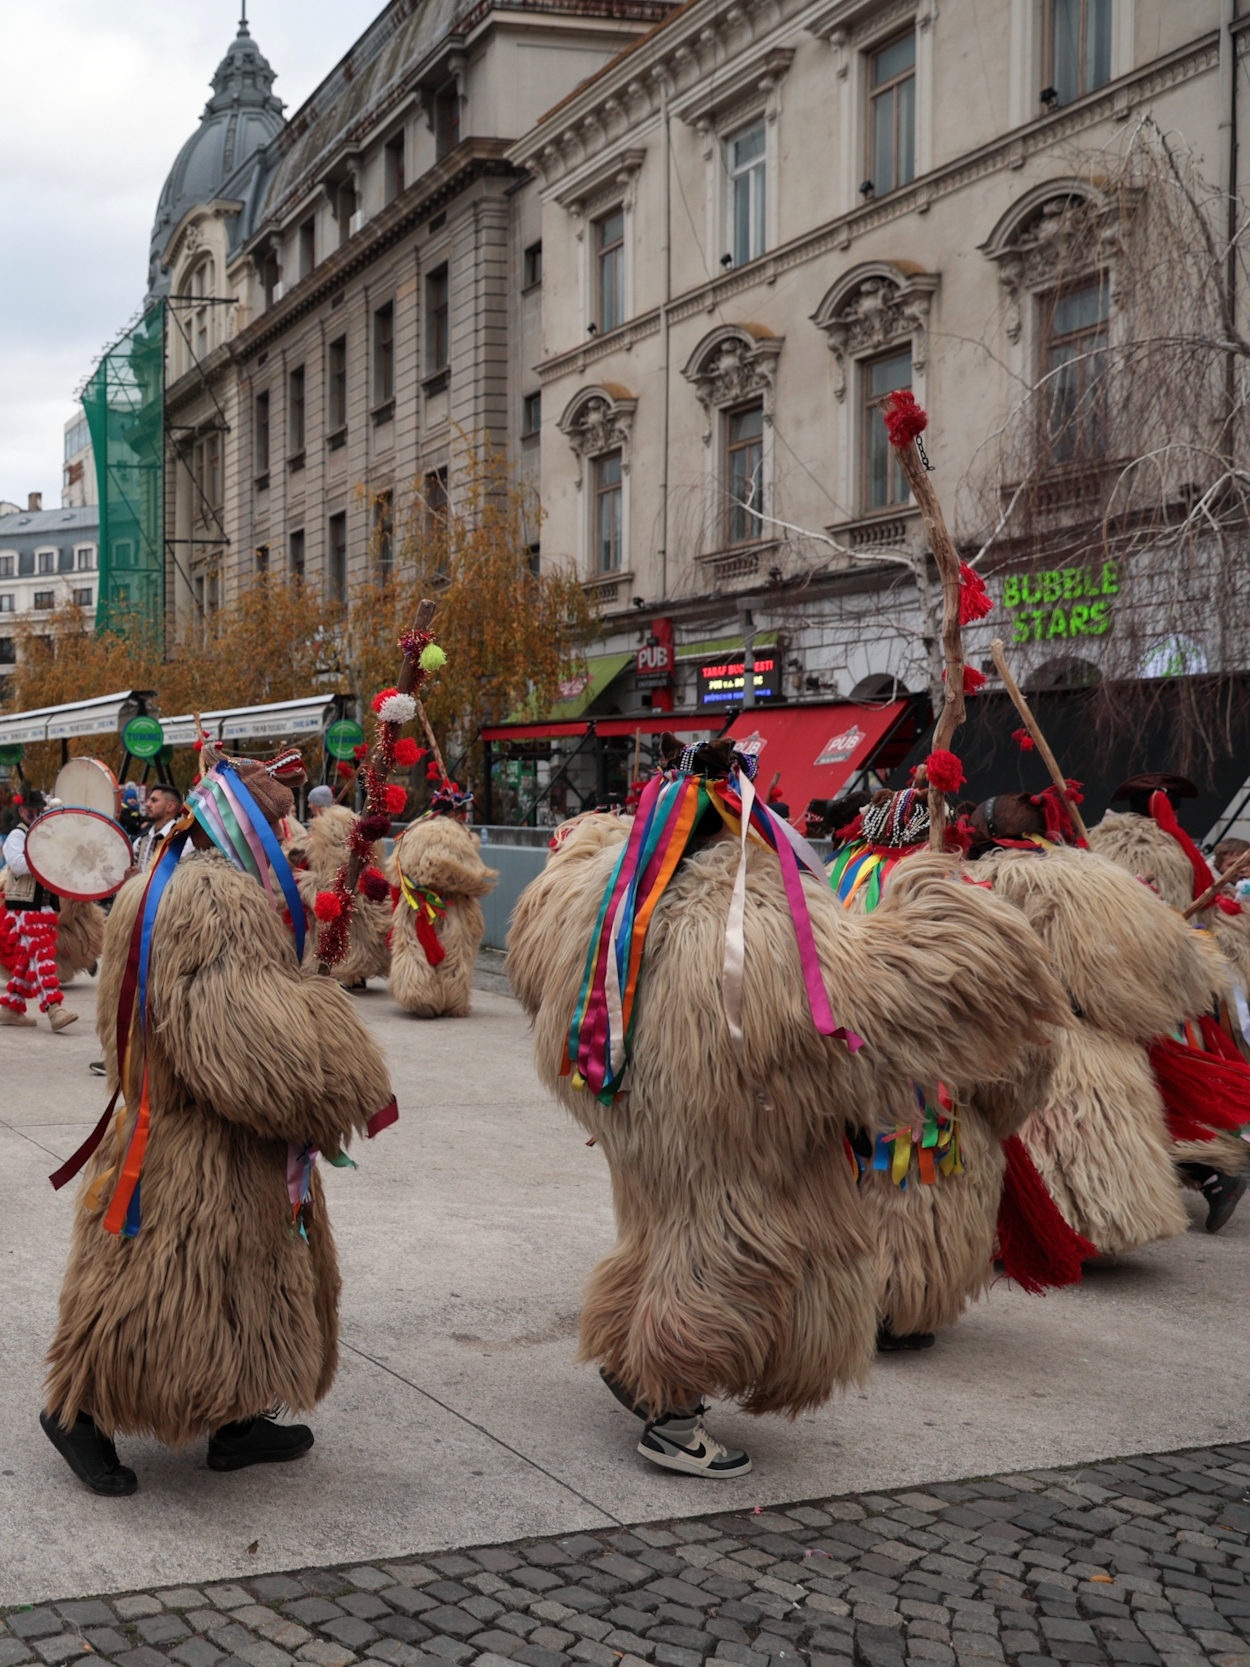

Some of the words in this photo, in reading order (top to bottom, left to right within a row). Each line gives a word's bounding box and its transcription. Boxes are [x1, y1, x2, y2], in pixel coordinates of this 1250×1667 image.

[1003, 560, 1120, 608] BUBBLE
[1011, 601, 1110, 643] STARS
[638, 646, 668, 670] PUB
[702, 665, 727, 678] TARAF
[727, 659, 774, 676] BUCESTI
[127, 732, 161, 742] TUBORG
[329, 735, 361, 744] TUBORG
[827, 735, 860, 752] PUB
[732, 741, 762, 755] PUB
